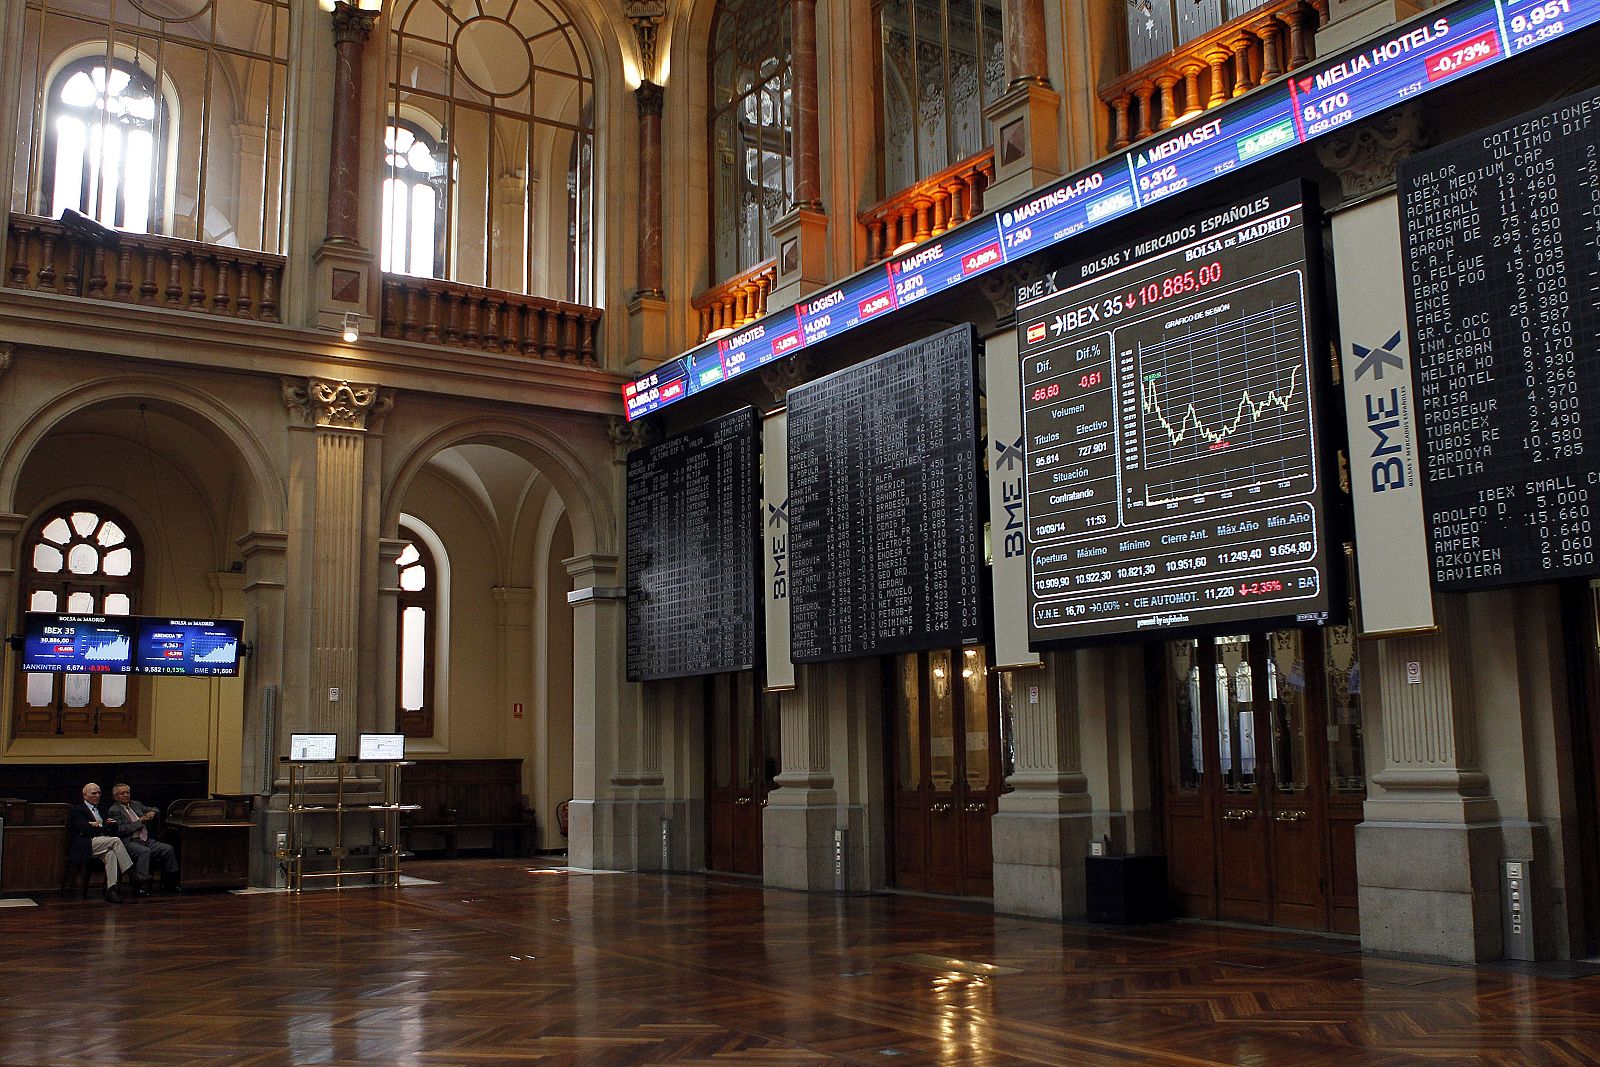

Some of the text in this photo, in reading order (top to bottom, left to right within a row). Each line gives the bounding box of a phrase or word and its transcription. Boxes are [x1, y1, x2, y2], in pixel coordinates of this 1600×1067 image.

[1510, 0, 1571, 33] 9,951
[1513, 22, 1564, 49] 70.338
[1316, 17, 1450, 90] MELIA HOTELS
[1432, 40, 1491, 72] -0,73%
[1303, 92, 1349, 122] 8,170
[1483, 97, 1600, 149] COTIZACIONES
[1148, 118, 1222, 163] MEDIASET
[1412, 115, 1592, 188] VALOR ULTIMO DIF
[1139, 165, 1178, 191] 9,312
[1407, 148, 1543, 205] IBEX MEDIUM CAP
[1407, 158, 1555, 219] ACERINOX 13.005
[1013, 173, 1103, 222] MARTINSA-FAD
[1407, 173, 1556, 232] ALMIRALL 11.460
[1005, 227, 1032, 248] 7,30
[1081, 196, 1270, 277] BOLSAS Y MERCADOS ESPAÑOLES
[1185, 216, 1291, 261] BOLSA DE MADRID
[1409, 213, 1480, 246] ATRESMED
[1410, 227, 1482, 259] BARON DE
[1412, 217, 1561, 272] C.A.F. 295.650
[902, 244, 944, 273] MAPFRE
[1412, 231, 1562, 286] D.FELGUE 4.260
[1414, 246, 1564, 300] EBRO FOO 15.095
[896, 274, 924, 296] 2,870
[1018, 281, 1044, 301] BME
[1063, 263, 1222, 335] IBEX 35 10.885,00
[808, 289, 845, 315] LOGISTA
[1415, 294, 1450, 313] ENCE
[1416, 308, 1451, 327] FAES
[729, 325, 766, 350] LINGOTES
[804, 315, 831, 334] 14,000
[1417, 312, 1490, 341] GR.C.OCC
[1419, 326, 1491, 355] INM.COLO
[1420, 340, 1492, 369] LIBERBAN
[1036, 343, 1101, 374] Dif. Dif.%
[1421, 335, 1573, 383] MELIA HO 8.170
[636, 373, 659, 392] IBEX 35
[1031, 371, 1101, 401] -66,60 -0,61
[1422, 370, 1495, 397] NH HOTEL
[1423, 366, 1576, 411] PRISA 0.266
[1051, 403, 1085, 419] Volumen
[1424, 399, 1498, 425] PROSEGUR
[1076, 419, 1108, 435] Efectivo
[1365, 387, 1406, 493] BME
[1425, 415, 1489, 439] TUBACEX
[1426, 411, 1581, 453] TUBOS RE 2.490
[1035, 441, 1107, 467] 95.814 727.901
[1428, 445, 1492, 467] ZARDOYA
[1429, 443, 1583, 482] ZELTIA 2.785
[1053, 467, 1089, 483] Situación
[1477, 471, 1600, 503] IBEX SMALL C
[1049, 488, 1094, 505] Contratando
[1432, 489, 1588, 525] ADOLFO D 5.000
[1002, 477, 1025, 558] BME
[1035, 514, 1107, 536] 10/09/14 11:53
[1433, 504, 1590, 539] ADVEO 15.660
[1036, 552, 1068, 567] Apertura
[1076, 546, 1108, 559] Máximo
[1119, 539, 1151, 552] Mínimo
[1161, 532, 1188, 545] Cierre
[1189, 528, 1209, 541] Ant.
[1435, 520, 1591, 553] AMPER 0.640
[772, 534, 787, 600] BME
[1035, 540, 1312, 590] 10.909,90 10.922,30 10.821,30 10.951,60 11.249,40 9.654,80
[1436, 548, 1501, 568] AZKOYEN
[1437, 552, 1594, 582] BAVIERA 8.500
[925, 610, 949, 622] 2.798
[1065, 604, 1086, 617] 16,70
[1133, 596, 1150, 608] CIE
[1150, 591, 1199, 607] AUTOMOT.
[1204, 586, 1235, 600] 11,220
[44, 626, 75, 635] IBEX 35
[925, 620, 949, 632] 8.645
